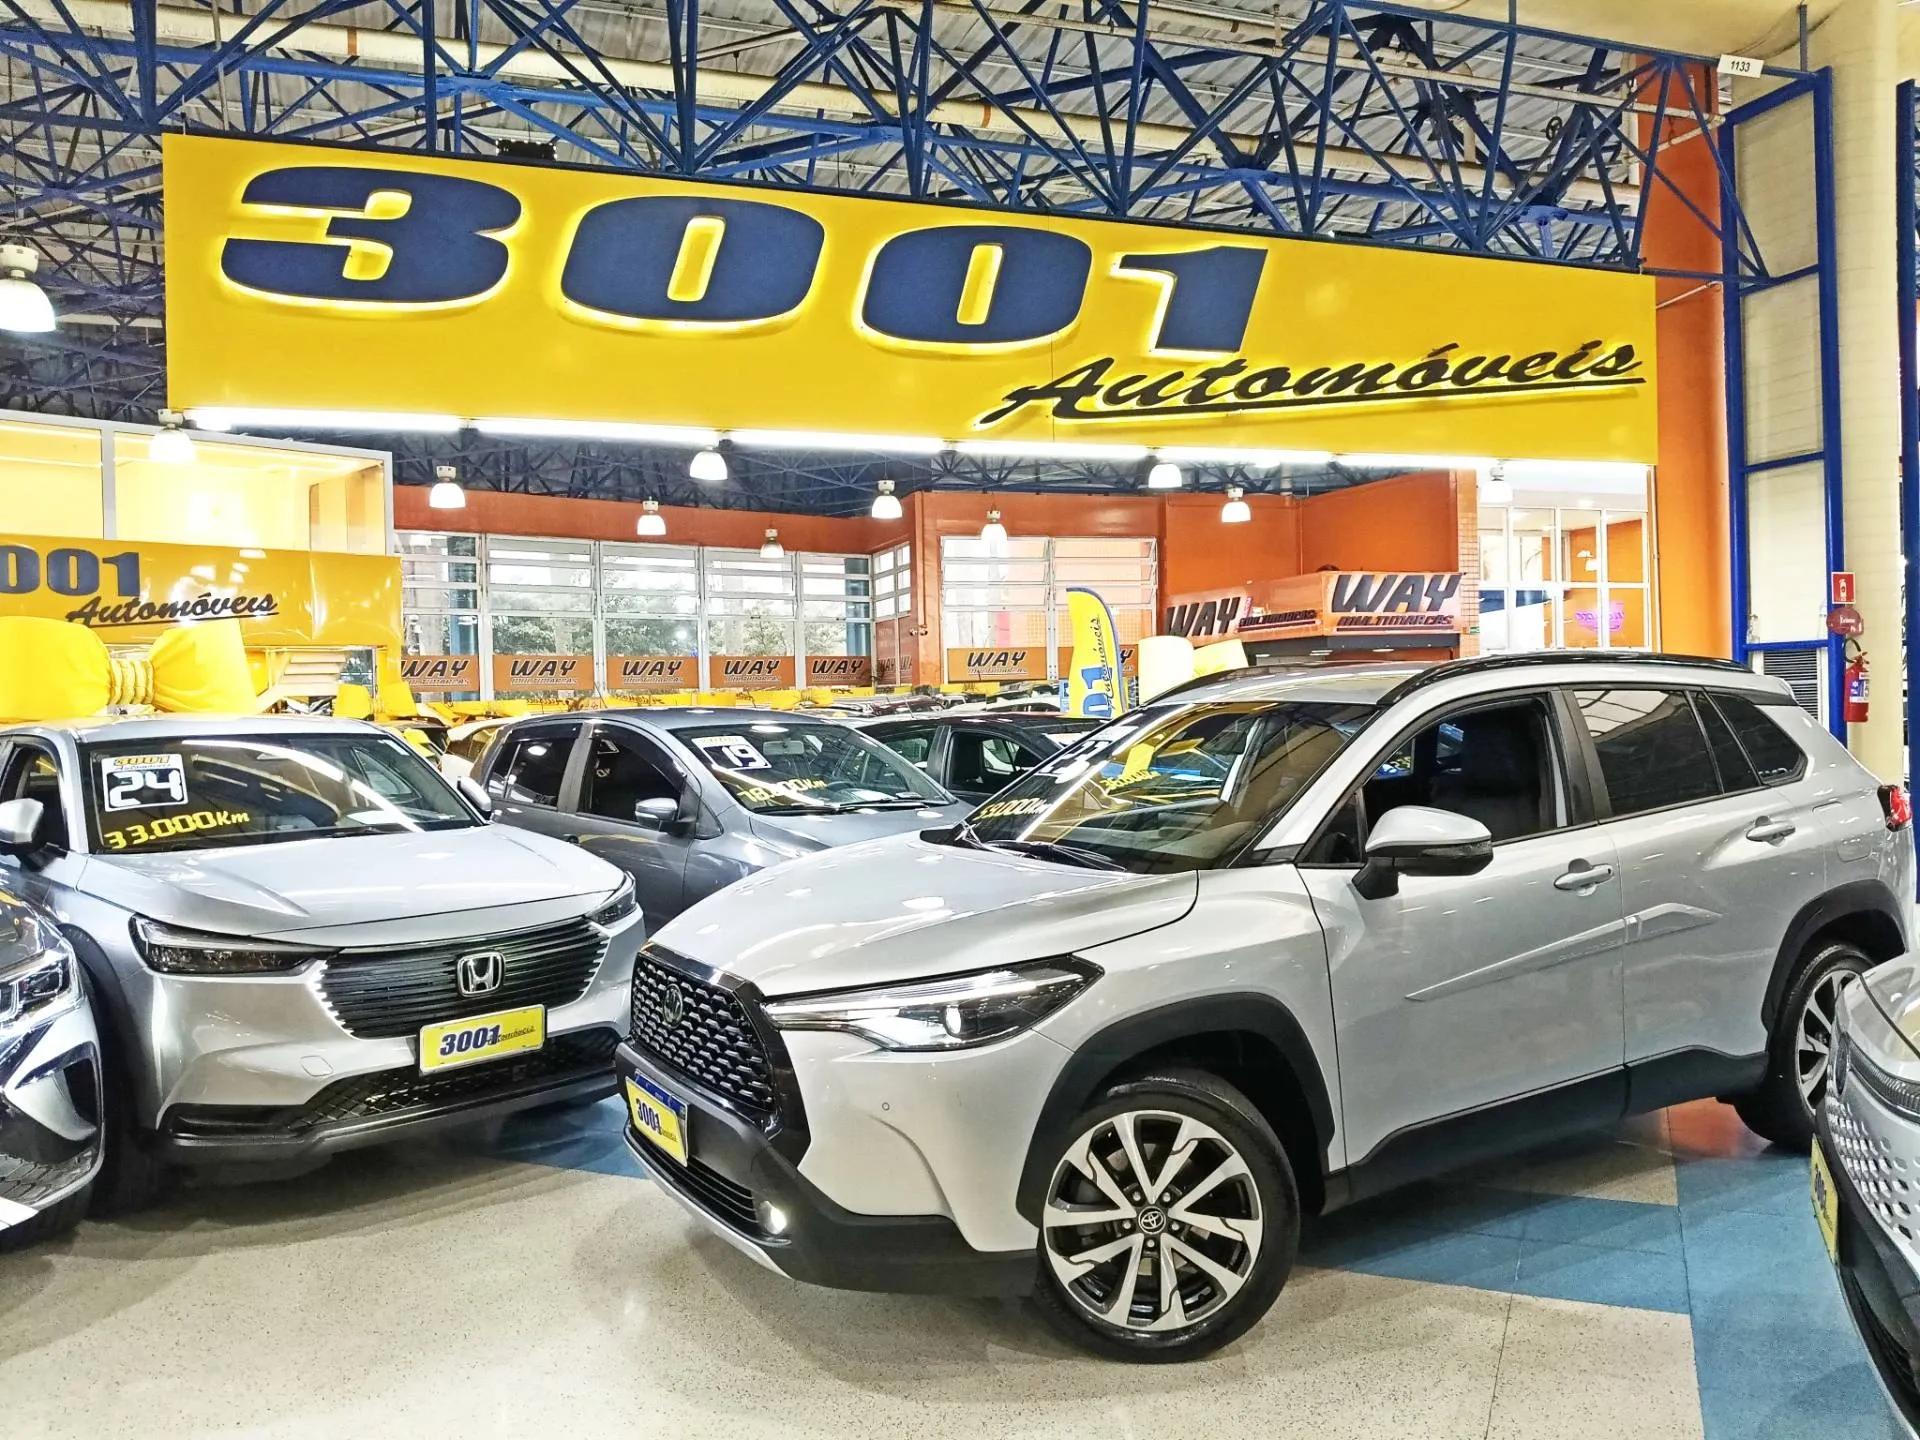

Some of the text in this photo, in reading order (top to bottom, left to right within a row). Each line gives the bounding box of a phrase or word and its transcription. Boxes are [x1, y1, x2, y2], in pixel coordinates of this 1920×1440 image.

[1730, 60, 1751, 73] 1133
[220, 165, 1268, 353] 3001
[979, 339, 1645, 424] Automóveis
[64, 592, 280, 628] Automóveis
[1332, 574, 1462, 613] WAY
[1165, 597, 1240, 637] WAY
[400, 660, 469, 677] WAY
[510, 659, 577, 677] WAY
[622, 660, 683, 676] WAY
[723, 659, 781, 675] WAY
[811, 658, 864, 675] WAY
[966, 651, 1027, 668] WAY
[109, 769, 184, 808] 24
[440, 1024, 501, 1057] 3001
[635, 1097, 661, 1134] 3001
